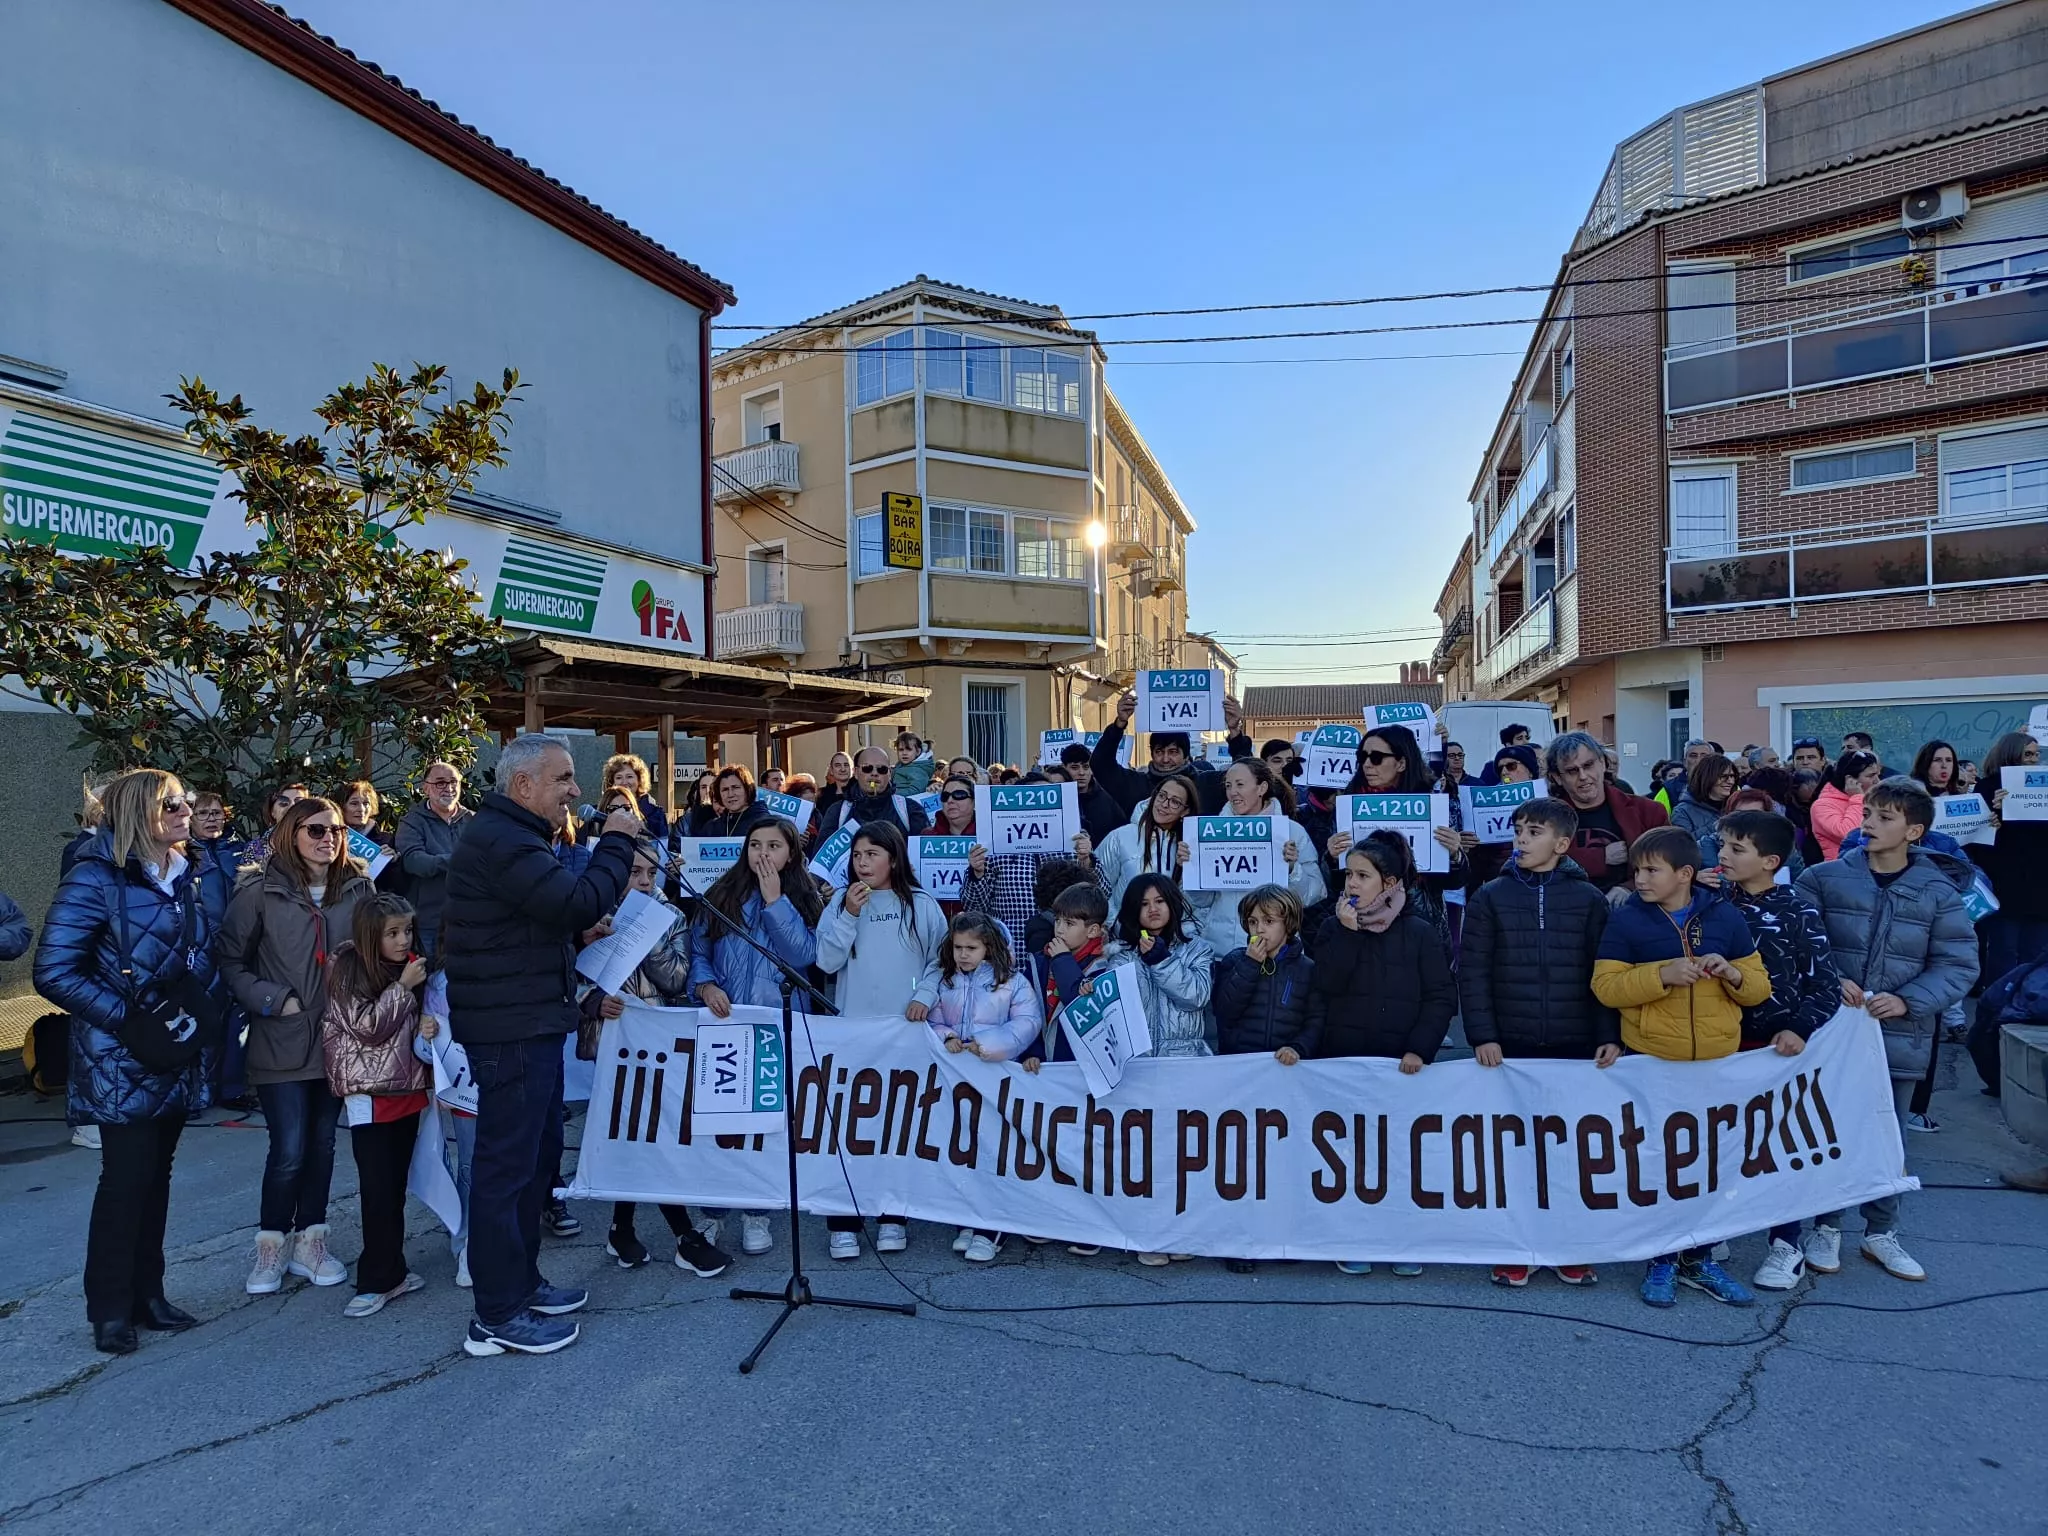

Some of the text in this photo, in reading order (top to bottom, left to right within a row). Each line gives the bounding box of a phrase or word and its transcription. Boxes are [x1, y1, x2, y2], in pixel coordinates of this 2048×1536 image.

[3, 493, 175, 551] SUPERMERCADO
[893, 514, 916, 529] BAR
[890, 537, 921, 556] BOIRA
[505, 588, 585, 622] SUPERMERCADO
[656, 597, 675, 608] GRUPO
[1152, 673, 1206, 688] A-1210
[1161, 702, 1198, 722] ¡YA!
[1380, 706, 1423, 720] A-1210
[1046, 731, 1072, 741] A-1210
[1316, 729, 1360, 745] A-121
[2025, 774, 2048, 785] A-1
[760, 794, 797, 812] -1210
[995, 789, 1058, 806] A-1210
[1475, 786, 1530, 804] A-1210
[1356, 800, 1426, 816] A-1210
[1946, 802, 1980, 814] A-1210
[1007, 822, 1049, 843] ¡YA!
[1202, 821, 1267, 837] A-1210
[700, 846, 742, 858] A-1210
[820, 832, 850, 869] A-1210
[688, 866, 720, 874] ARREGLO
[1214, 855, 1258, 878] ¡YA!
[932, 869, 963, 888] ¡YA
[870, 912, 899, 923] LAURA
[712, 1043, 738, 1094] ¡YA!
[760, 1028, 779, 1106] A-1210
[997, 1076, 1153, 1199] lucha
[1175, 1108, 1288, 1216] por
[1311, 1110, 1388, 1205] su
[1410, 1067, 1842, 1210] carretera!!!
